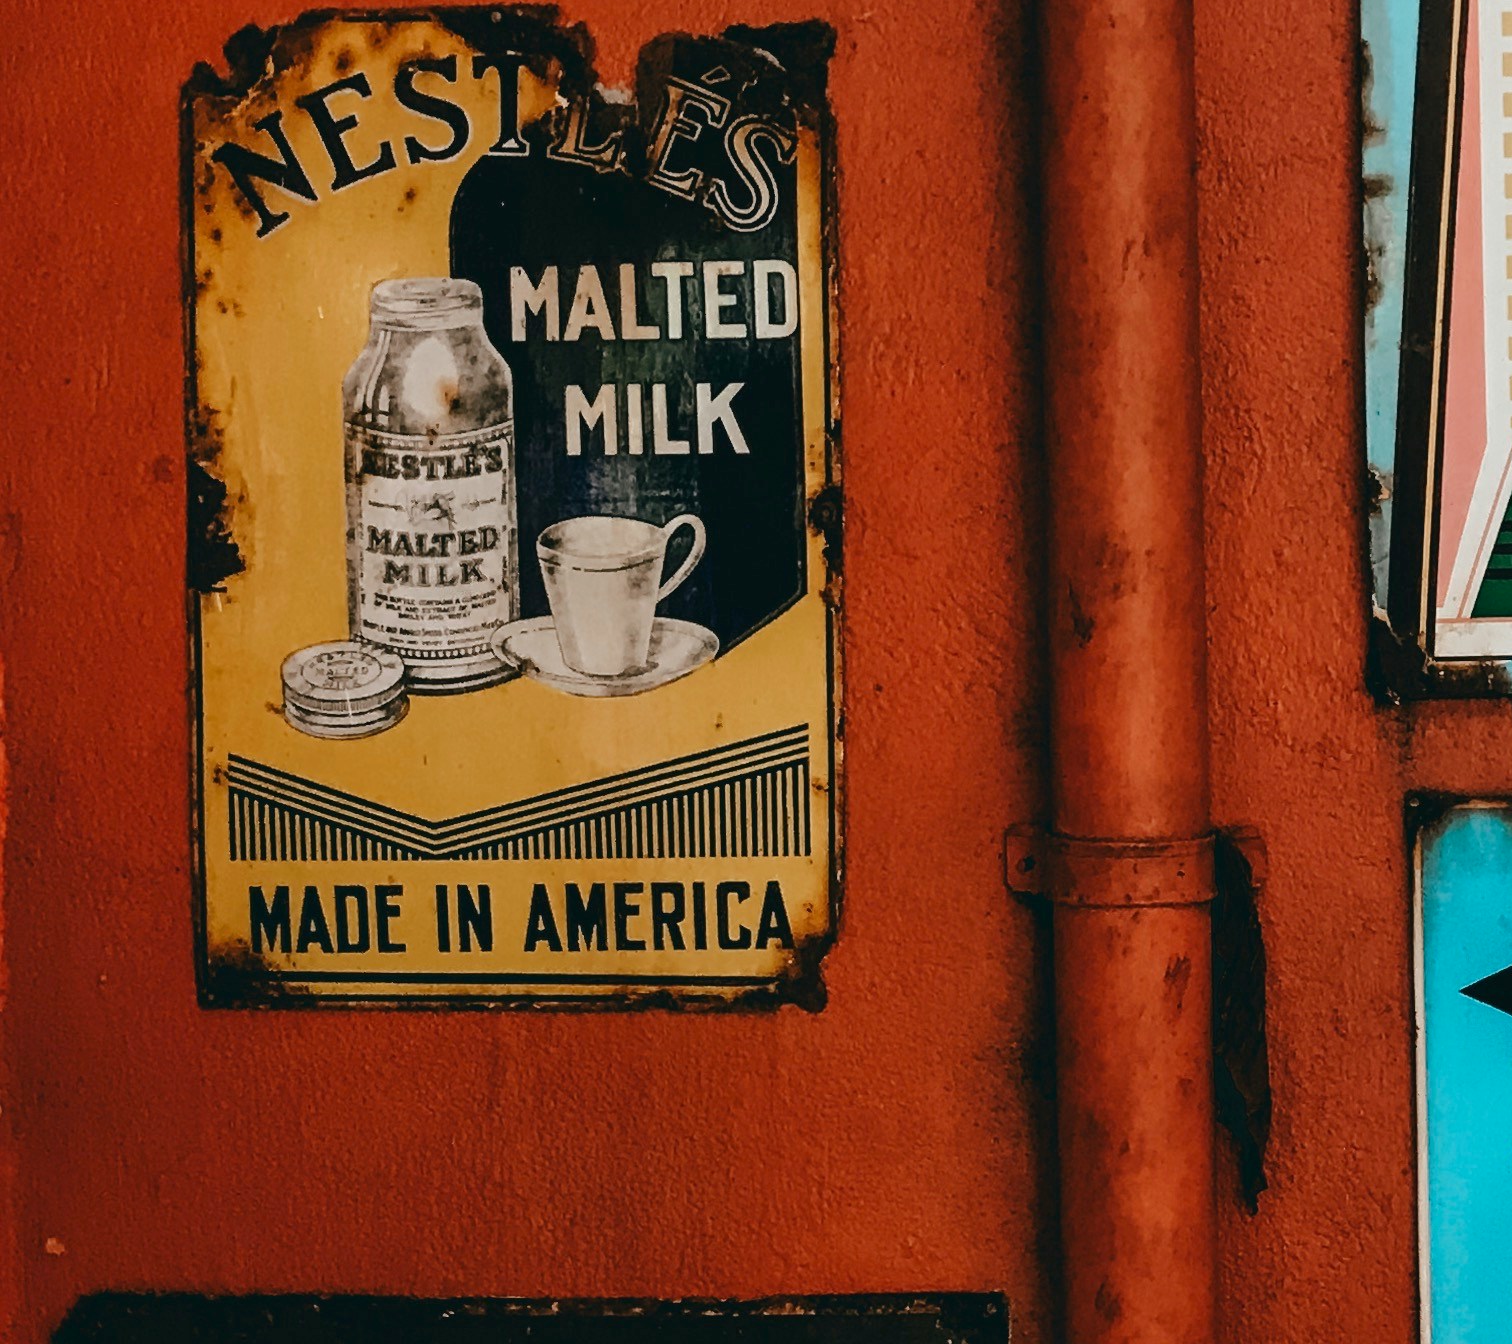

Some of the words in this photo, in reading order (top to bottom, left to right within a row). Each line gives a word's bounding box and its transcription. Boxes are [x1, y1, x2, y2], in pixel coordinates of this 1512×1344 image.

[509, 258, 799, 343] MALTED
[564, 380, 752, 457] MILK
[366, 524, 500, 557] MALTED
[248, 883, 406, 954] MADE
[436, 882, 494, 953] IN
[523, 879, 796, 953] AMERICA
